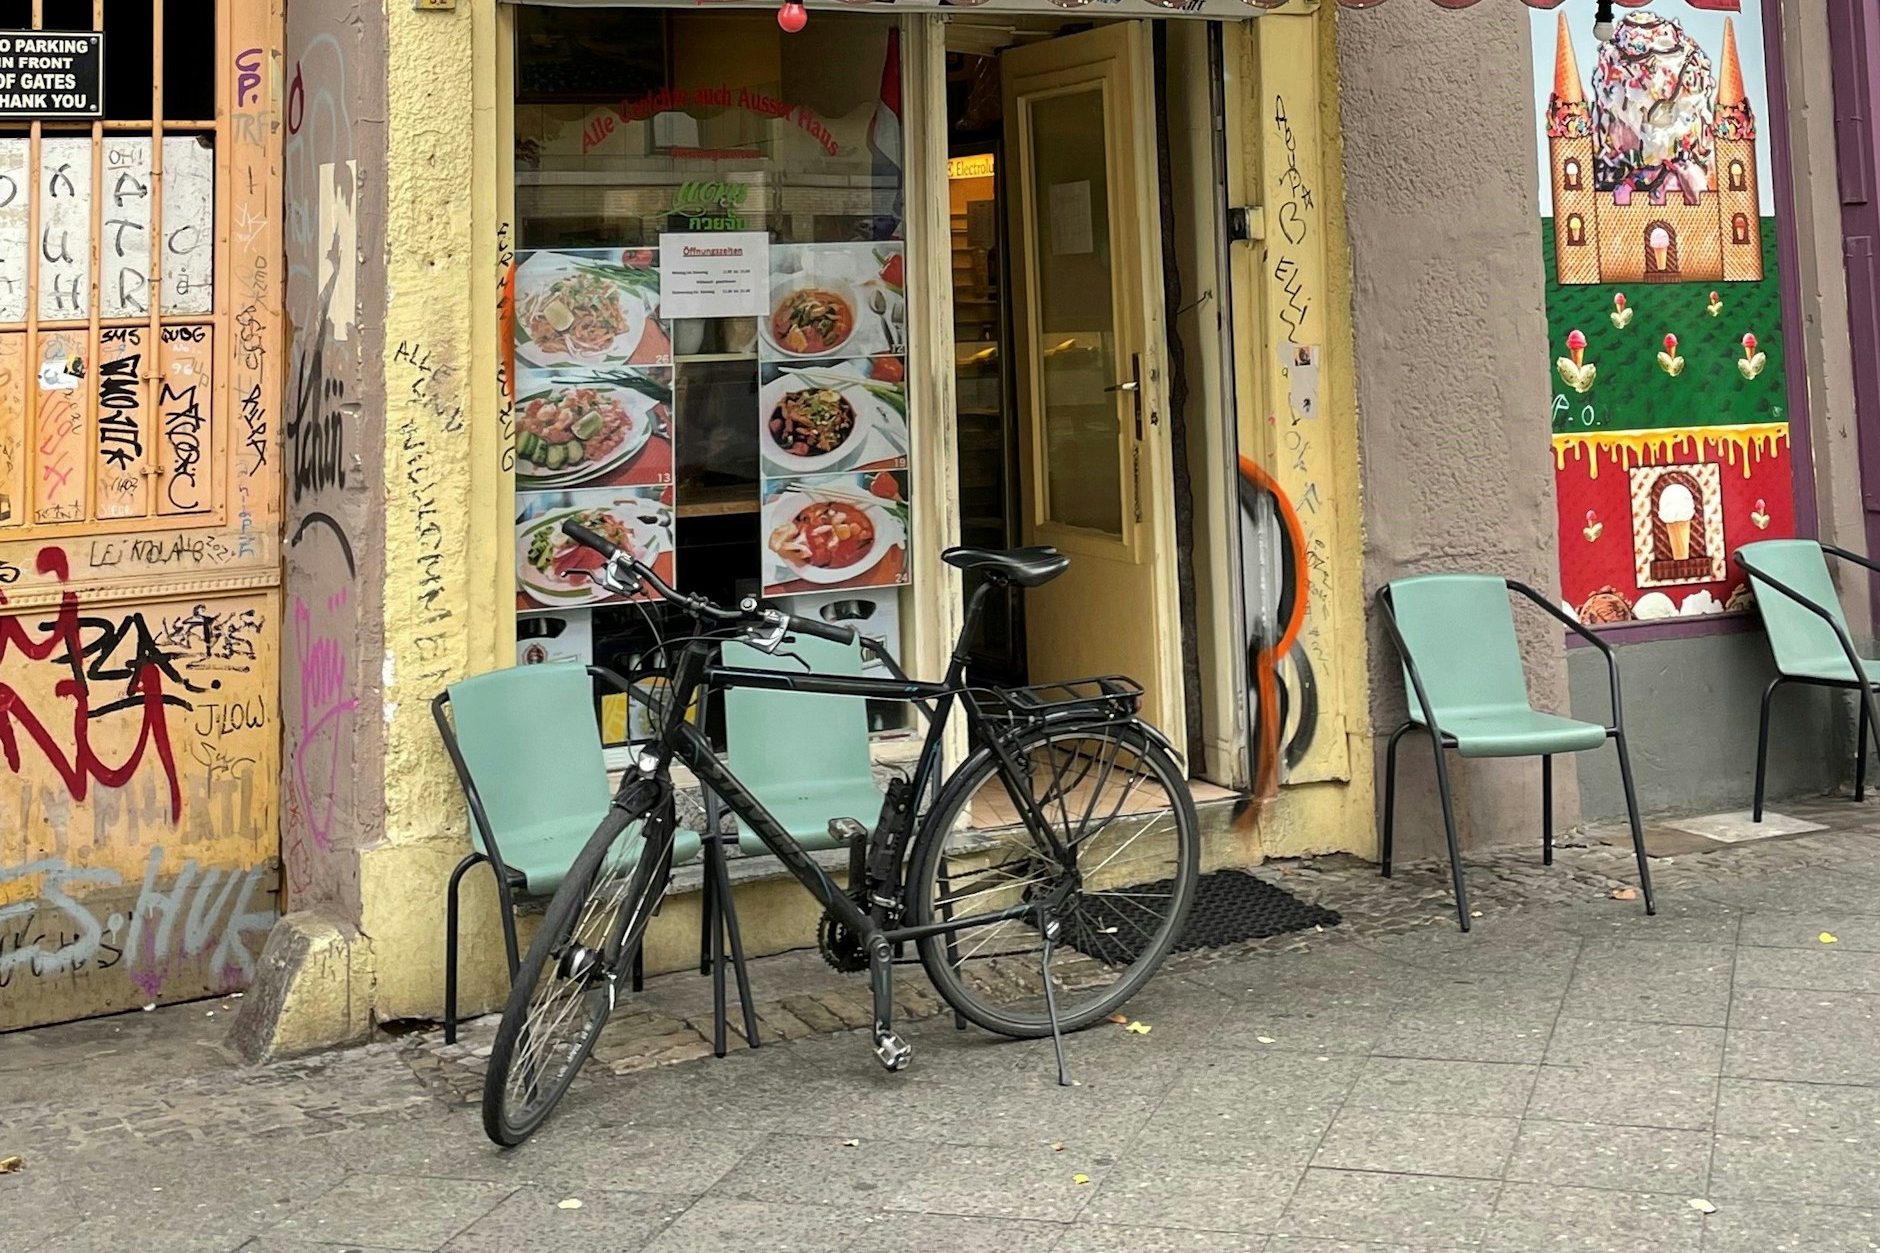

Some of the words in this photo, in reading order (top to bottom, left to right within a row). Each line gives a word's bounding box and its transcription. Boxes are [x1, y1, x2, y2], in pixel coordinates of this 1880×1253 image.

[15, 39, 88, 53] PARKING
[0, 56, 14, 68] N
[18, 57, 73, 69] FRONT
[20, 73, 76, 90] GATES
[51, 94, 86, 109] YOU
[582, 114, 615, 154] Alle
[694, 82, 731, 107] auch
[738, 86, 796, 122] Ausser
[797, 106, 840, 156] Haus
[683, 245, 743, 257] Öffnungszeiten
[657, 473, 671, 483] 13
[895, 573, 908, 582] 24
[702, 763, 807, 869] STEVENS
